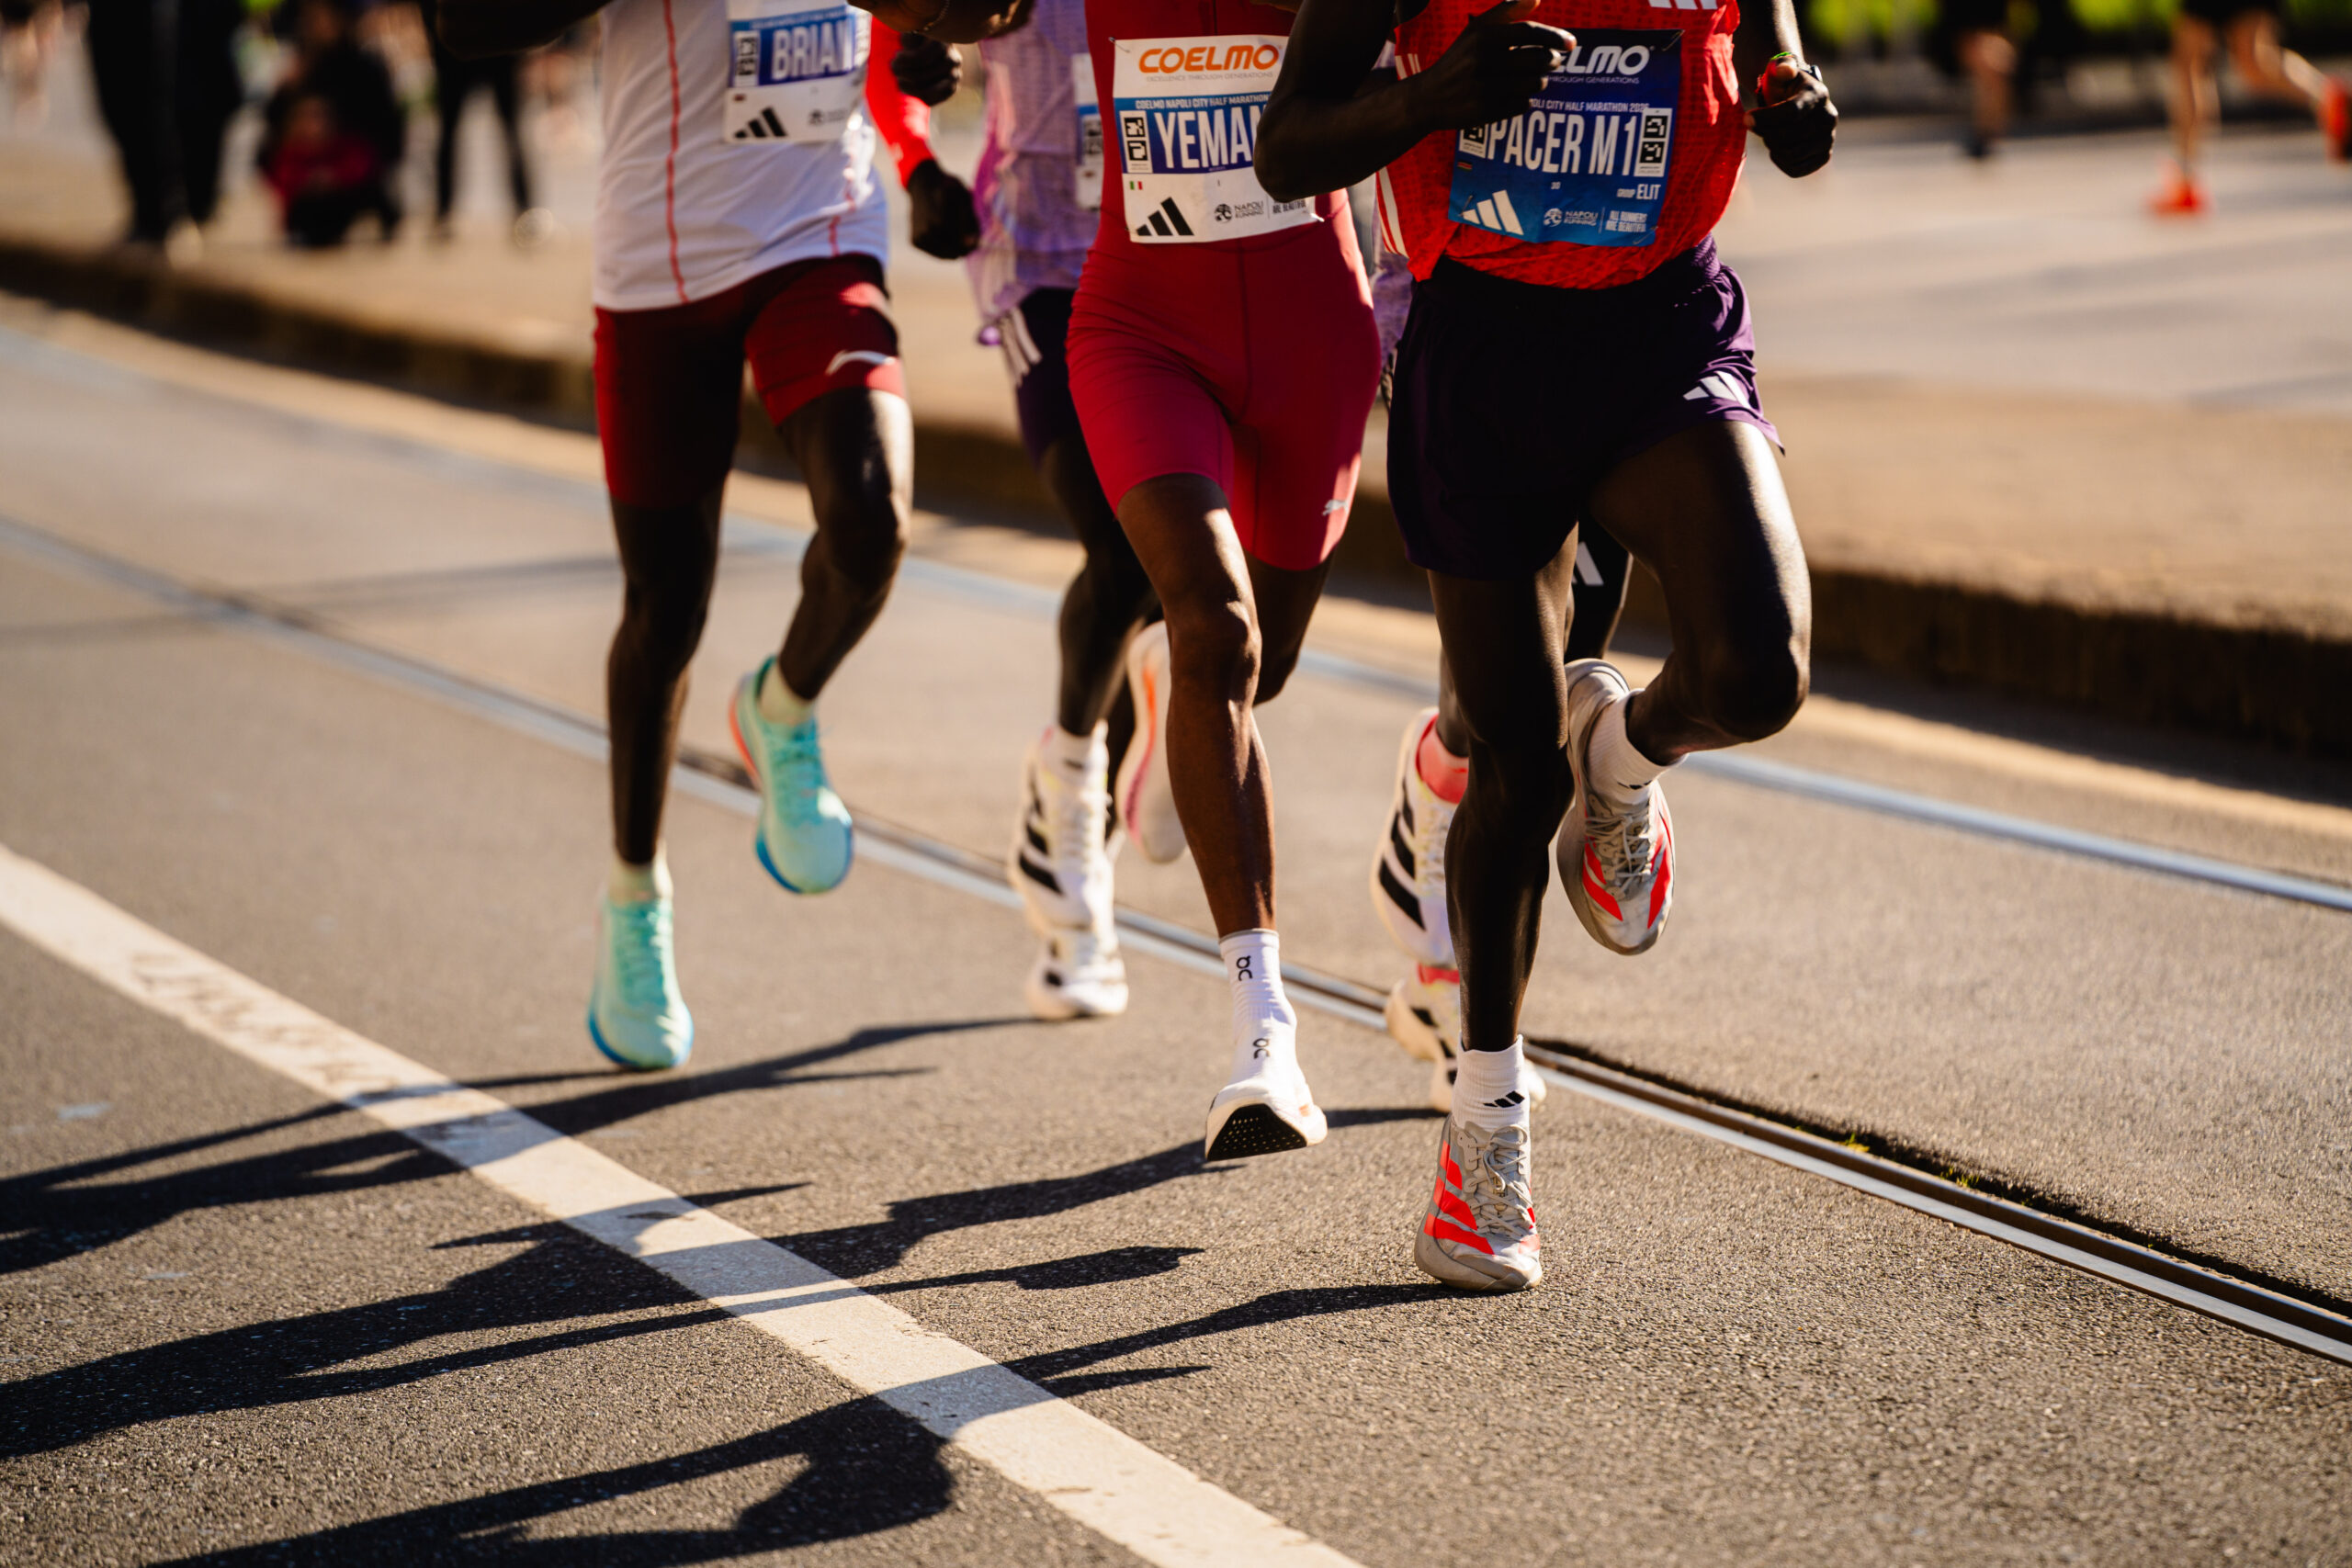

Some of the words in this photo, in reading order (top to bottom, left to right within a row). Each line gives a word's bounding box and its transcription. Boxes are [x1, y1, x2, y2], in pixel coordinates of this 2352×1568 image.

[1138, 44, 1280, 74] COELMO
[1551, 45, 1651, 75] LMO
[1146, 74, 1186, 83] EXCELLENCE
[1187, 73, 1224, 81] THROUGH
[1225, 71, 1274, 80] GENERATIONS
[1586, 76, 1640, 85] GENERATIONS
[1135, 99, 1165, 109] COELMO
[1166, 97, 1193, 108] NAPOLI
[1193, 96, 1209, 107] CITY
[1209, 96, 1228, 107] HALF
[1228, 93, 1269, 105] MARATHON
[1546, 99, 1564, 110] CITY
[1565, 101, 1585, 111] HALF
[1586, 101, 1628, 112] MARATHON
[1487, 110, 1585, 174] PACER
[1589, 115, 1620, 175] M
[1636, 183, 1661, 200] ELIT
[1234, 200, 1264, 211] NAPOLI
[1565, 210, 1599, 220] NAPOLI
